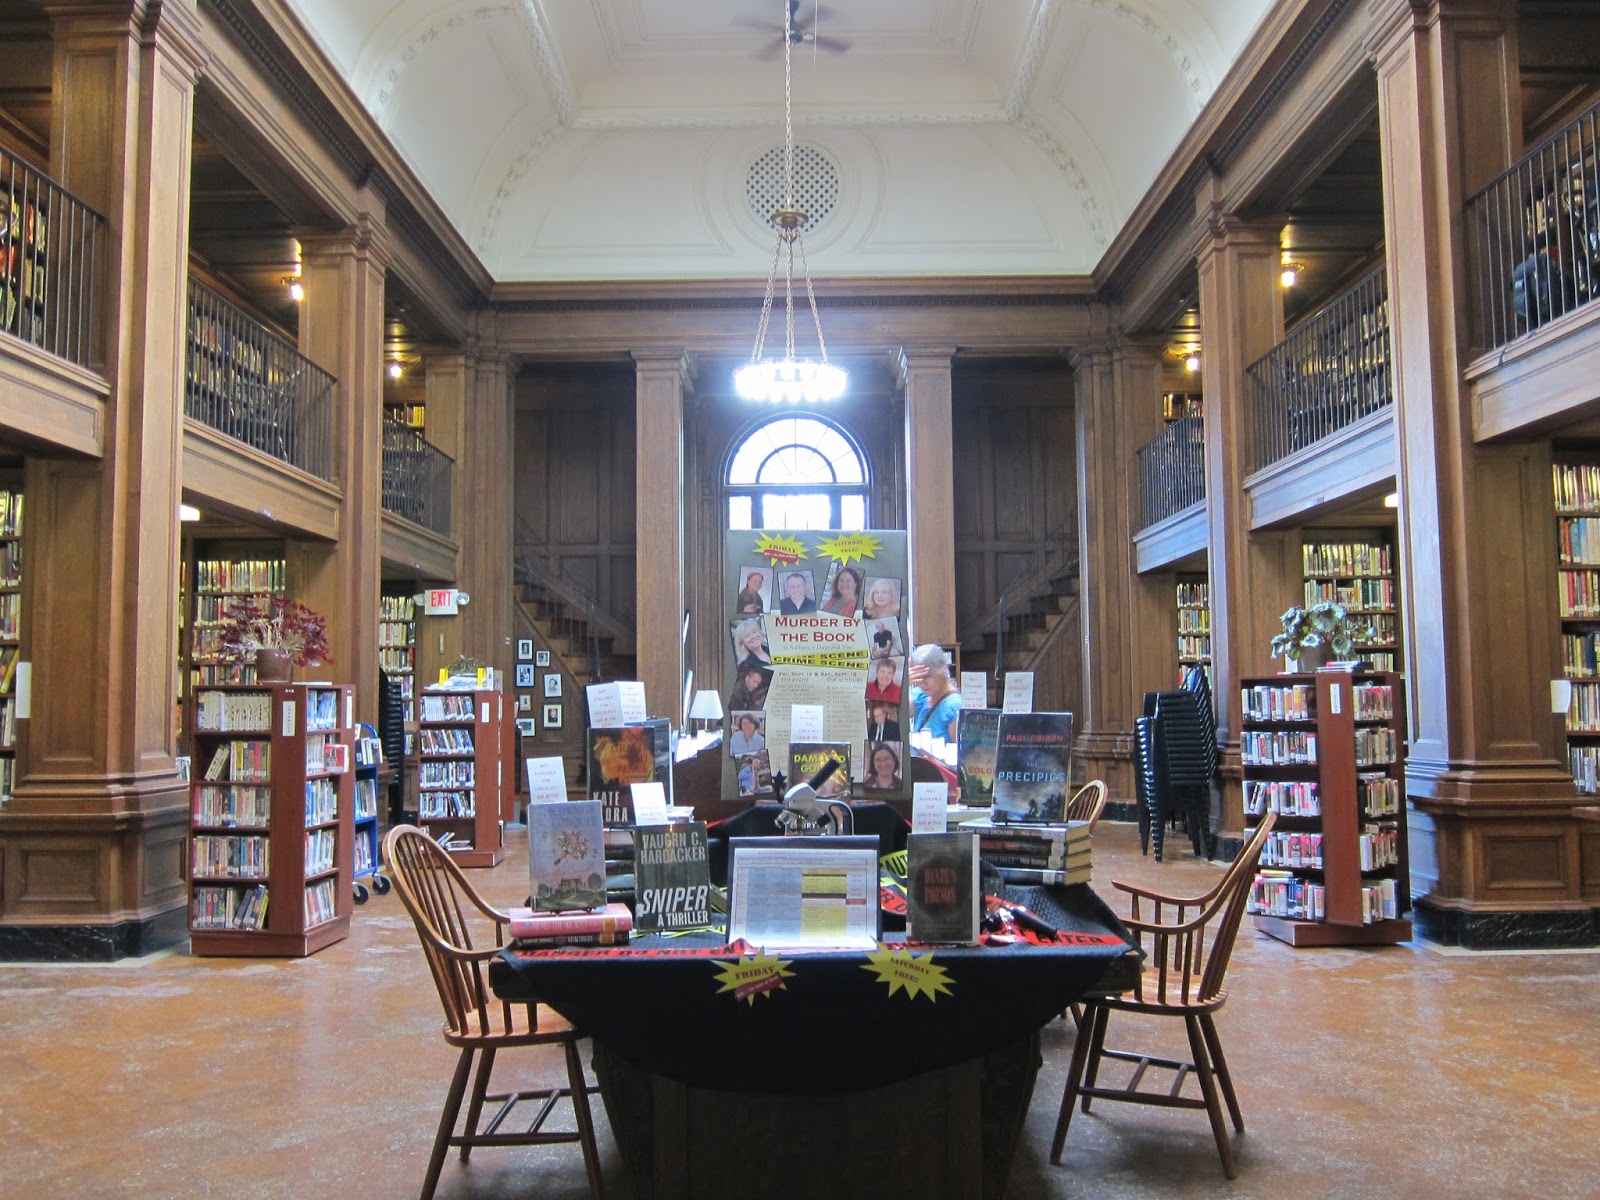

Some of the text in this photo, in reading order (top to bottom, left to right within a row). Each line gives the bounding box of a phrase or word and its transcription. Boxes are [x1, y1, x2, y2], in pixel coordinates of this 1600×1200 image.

[769, 544, 796, 553] FRIDAY
[431, 591, 452, 607] EXIT
[775, 616, 860, 627] MURDER BY
[780, 632, 855, 642] THE BOOK
[820, 651, 864, 660] SCENE
[773, 656, 864, 669] CRIME SCENE
[1006, 734, 1026, 742] PAUL
[794, 754, 846, 763] DAMD
[998, 771, 1066, 783] PRECIPICE
[593, 791, 620, 806] KATE
[642, 831, 703, 849] VAUGHN C.
[641, 846, 706, 865] HARDACKER
[642, 885, 709, 915] SNIPER
[657, 910, 709, 927] A THRILLER
[889, 956, 930, 975] SATURDAY
[735, 966, 774, 980] FRIDAY
